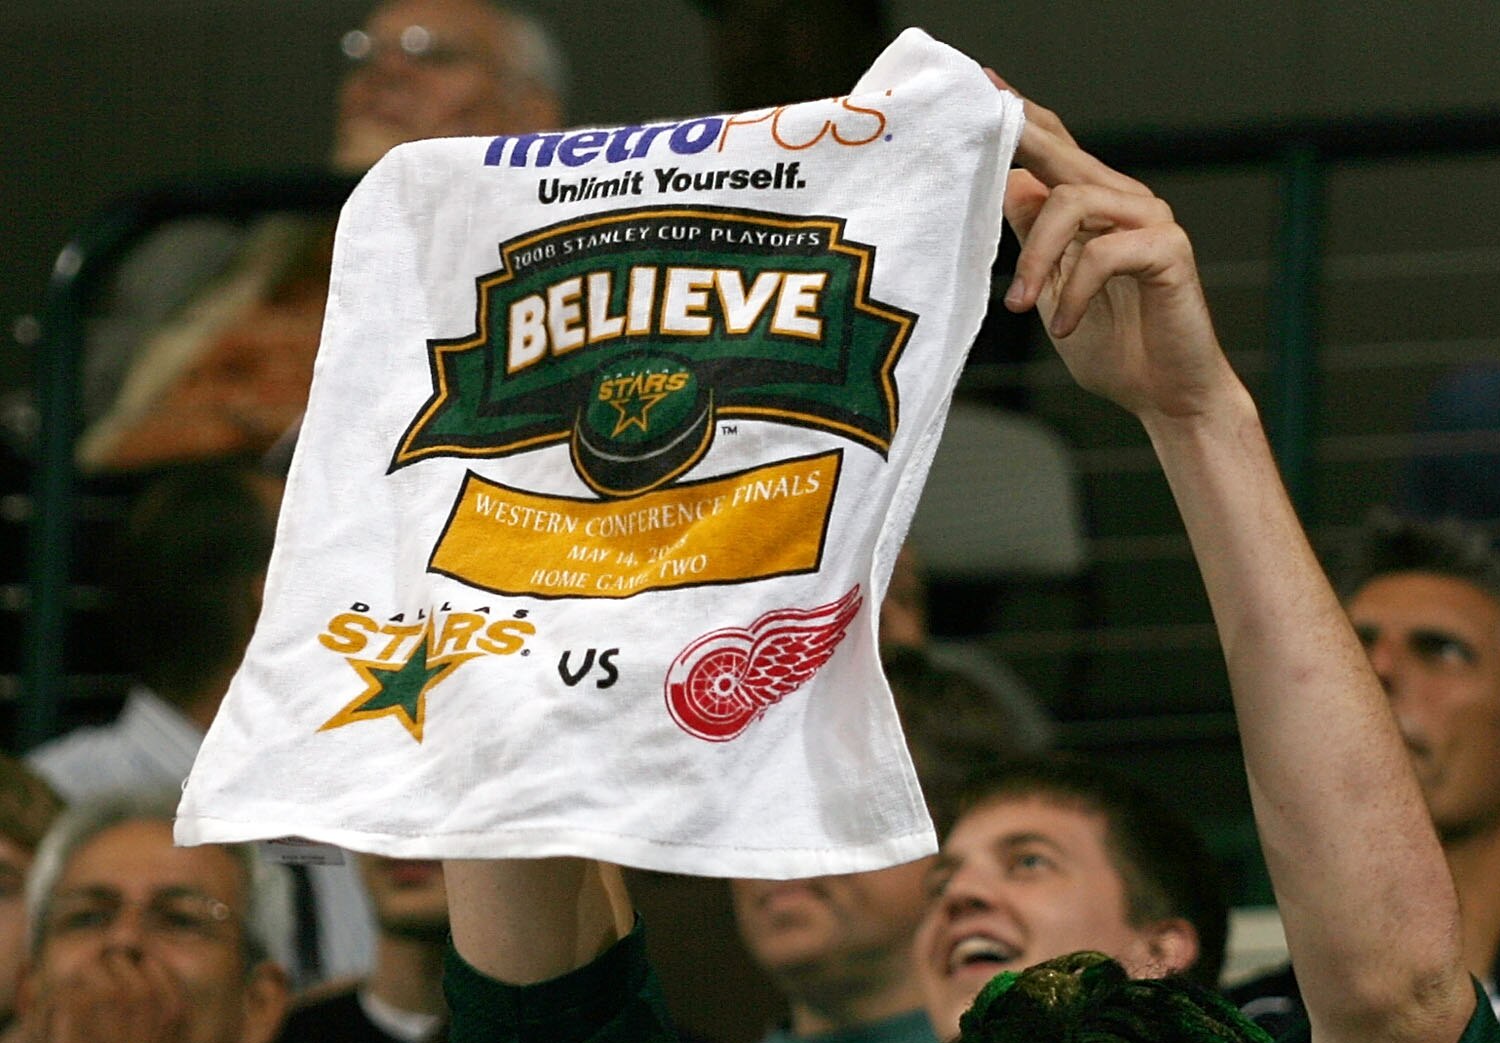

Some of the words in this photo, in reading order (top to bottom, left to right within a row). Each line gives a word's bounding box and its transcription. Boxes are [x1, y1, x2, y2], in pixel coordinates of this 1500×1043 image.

[538, 167, 643, 205] Unlimit
[653, 161, 806, 194] Yourself.
[513, 244, 557, 270] 2008
[562, 226, 650, 255] STANLEY
[657, 225, 701, 241] CUP
[710, 228, 821, 248] PLAYOFFS
[507, 266, 828, 375] BELIEVE
[598, 372, 690, 401] STARS
[474, 492, 578, 535] WESTERN
[584, 495, 727, 539] CONFERENCE
[730, 470, 821, 507] FINALS
[530, 569, 587, 588] HOME
[658, 554, 710, 579] TWO
[566, 544, 610, 562] MAY
[317, 605, 537, 661] STARS
[349, 601, 529, 623] DALLAS
